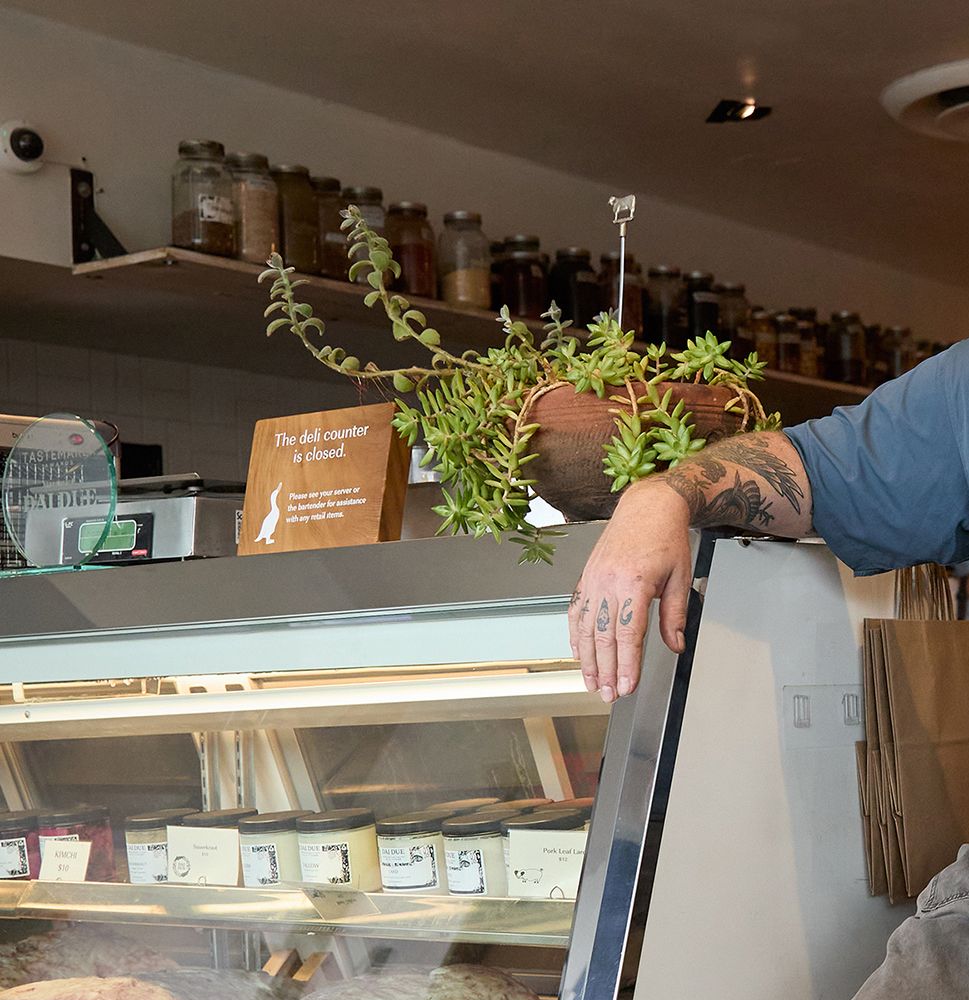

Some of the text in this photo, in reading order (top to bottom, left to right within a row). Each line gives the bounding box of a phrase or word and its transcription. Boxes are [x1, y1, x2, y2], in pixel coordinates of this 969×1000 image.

[275, 425, 369, 448] The deli counter
[293, 442, 346, 463] is closed.
[288, 492, 307, 500] Please
[319, 489, 333, 499] your
[334, 488, 352, 496] server
[287, 497, 366, 512] the bartender for assistance
[286, 514, 299, 523] with
[299, 515, 310, 524] any
[311, 511, 326, 520] retail
[55, 851, 77, 859] KIMCHI
